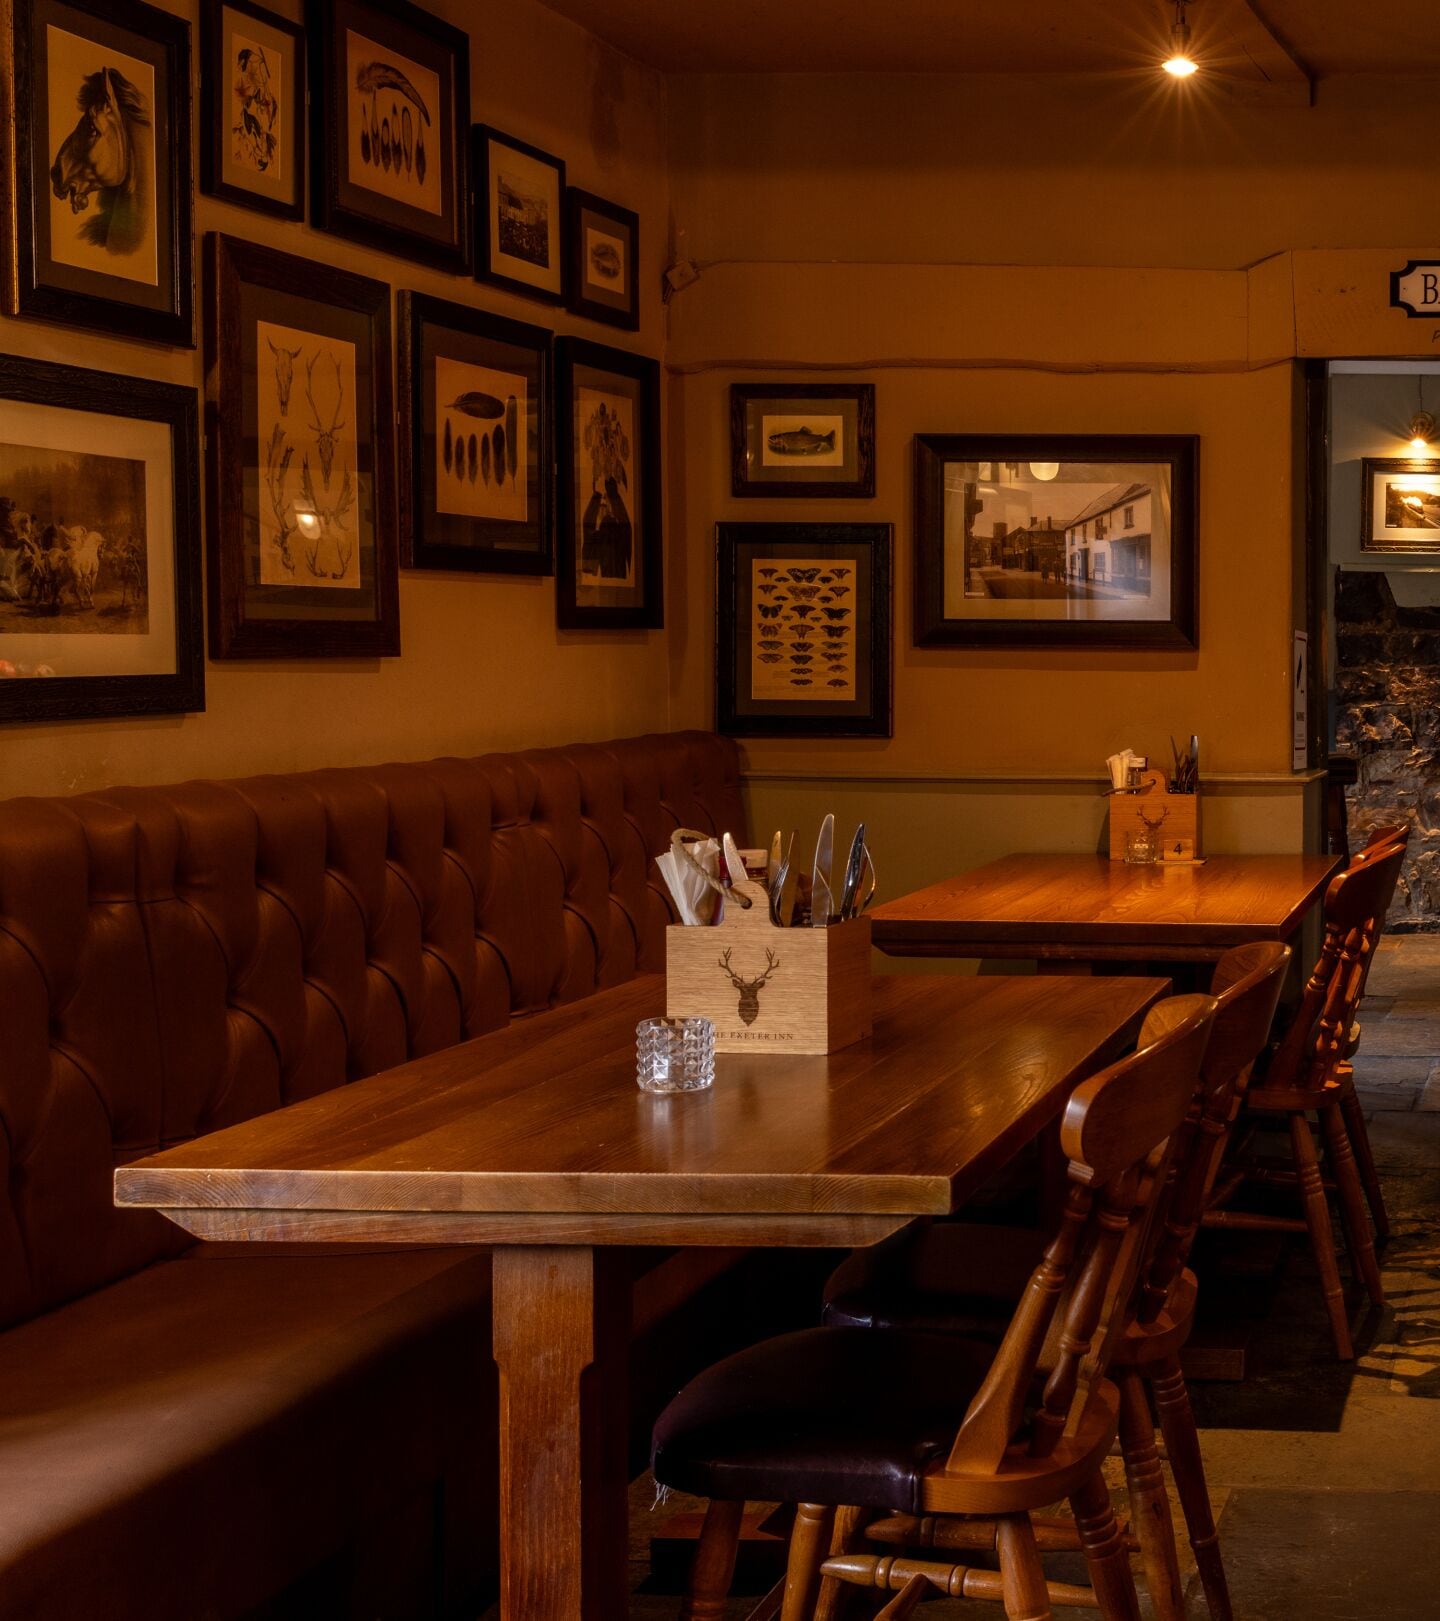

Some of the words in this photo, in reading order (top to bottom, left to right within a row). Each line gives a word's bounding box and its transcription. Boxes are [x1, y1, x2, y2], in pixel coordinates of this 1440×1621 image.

[1173, 842, 1183, 856] 4
[714, 1031, 726, 1039] HE
[730, 1032, 770, 1040] EXETER
